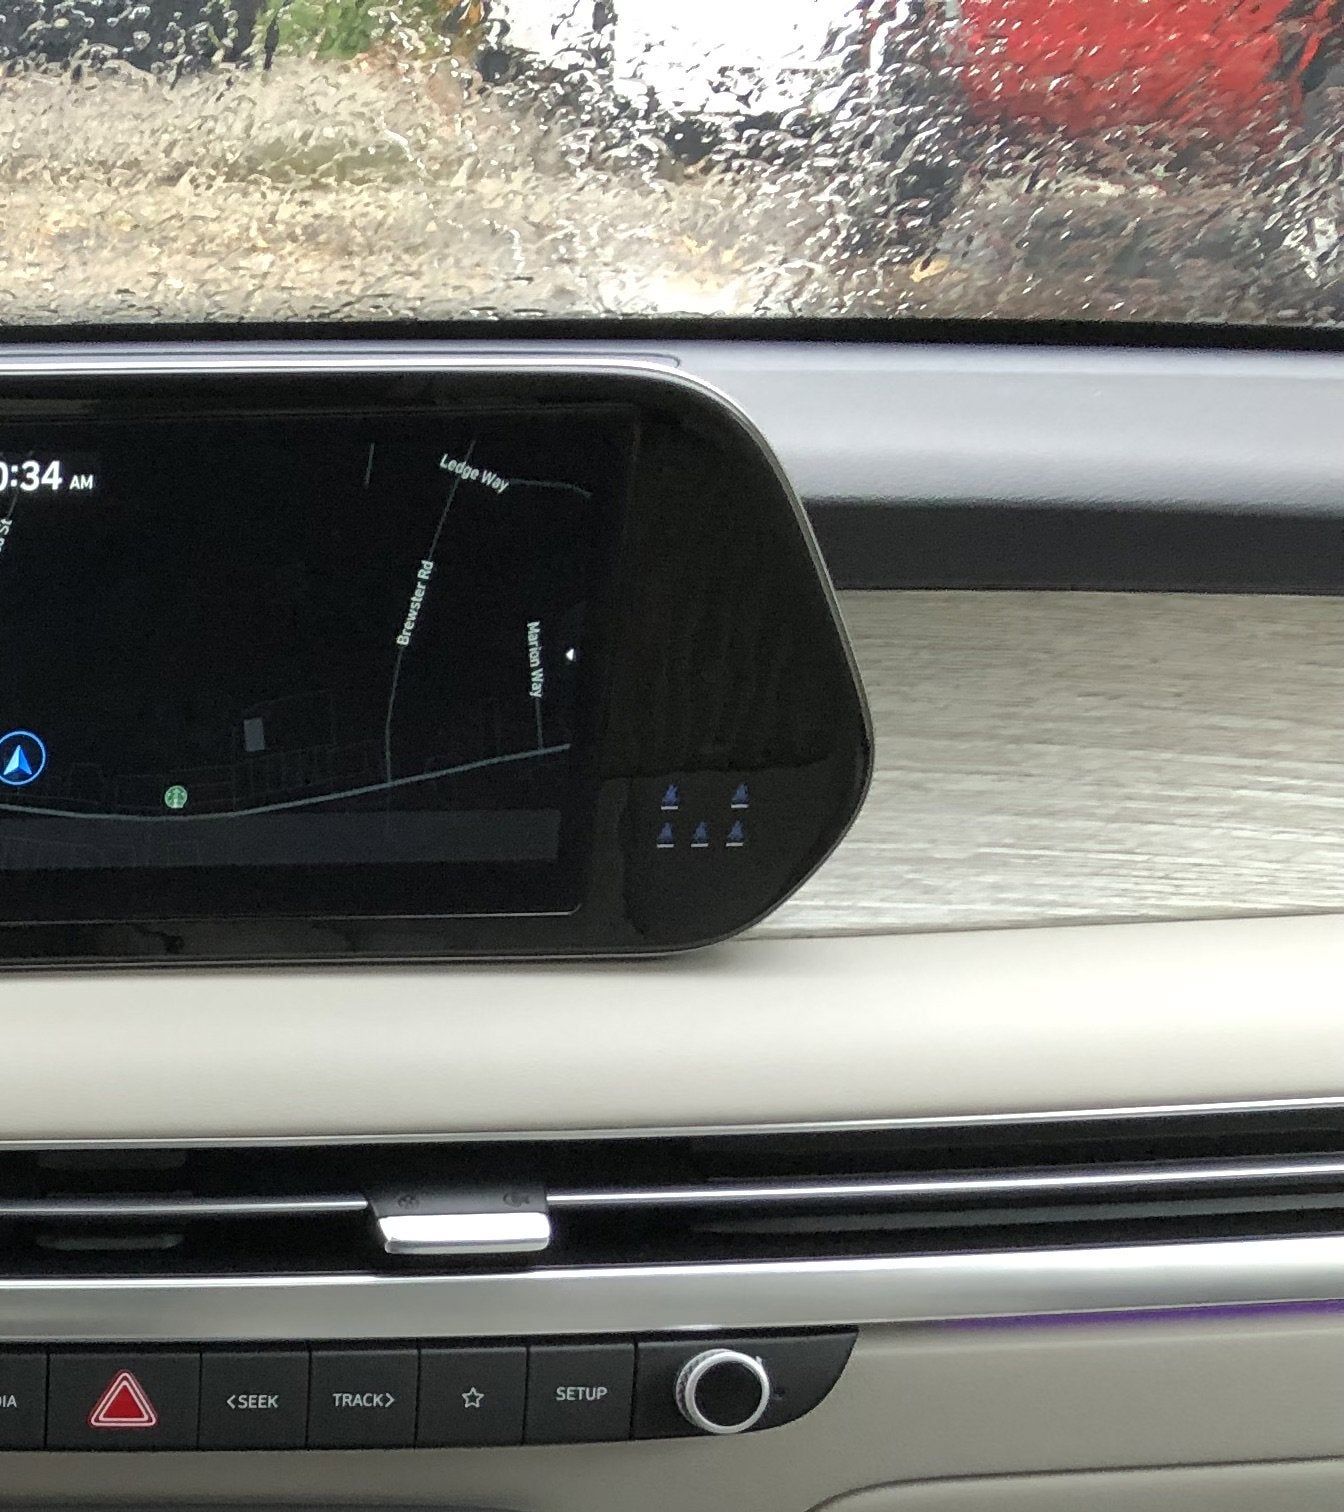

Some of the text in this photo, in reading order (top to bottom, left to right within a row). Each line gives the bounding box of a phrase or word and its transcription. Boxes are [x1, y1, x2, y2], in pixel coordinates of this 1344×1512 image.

[69, 474, 94, 490] AM
[439, 453, 510, 494] Ledge Way
[396, 560, 434, 646] Brewster Rd
[526, 620, 544, 698] Marion Way
[555, 1386, 608, 1402] SETUP
